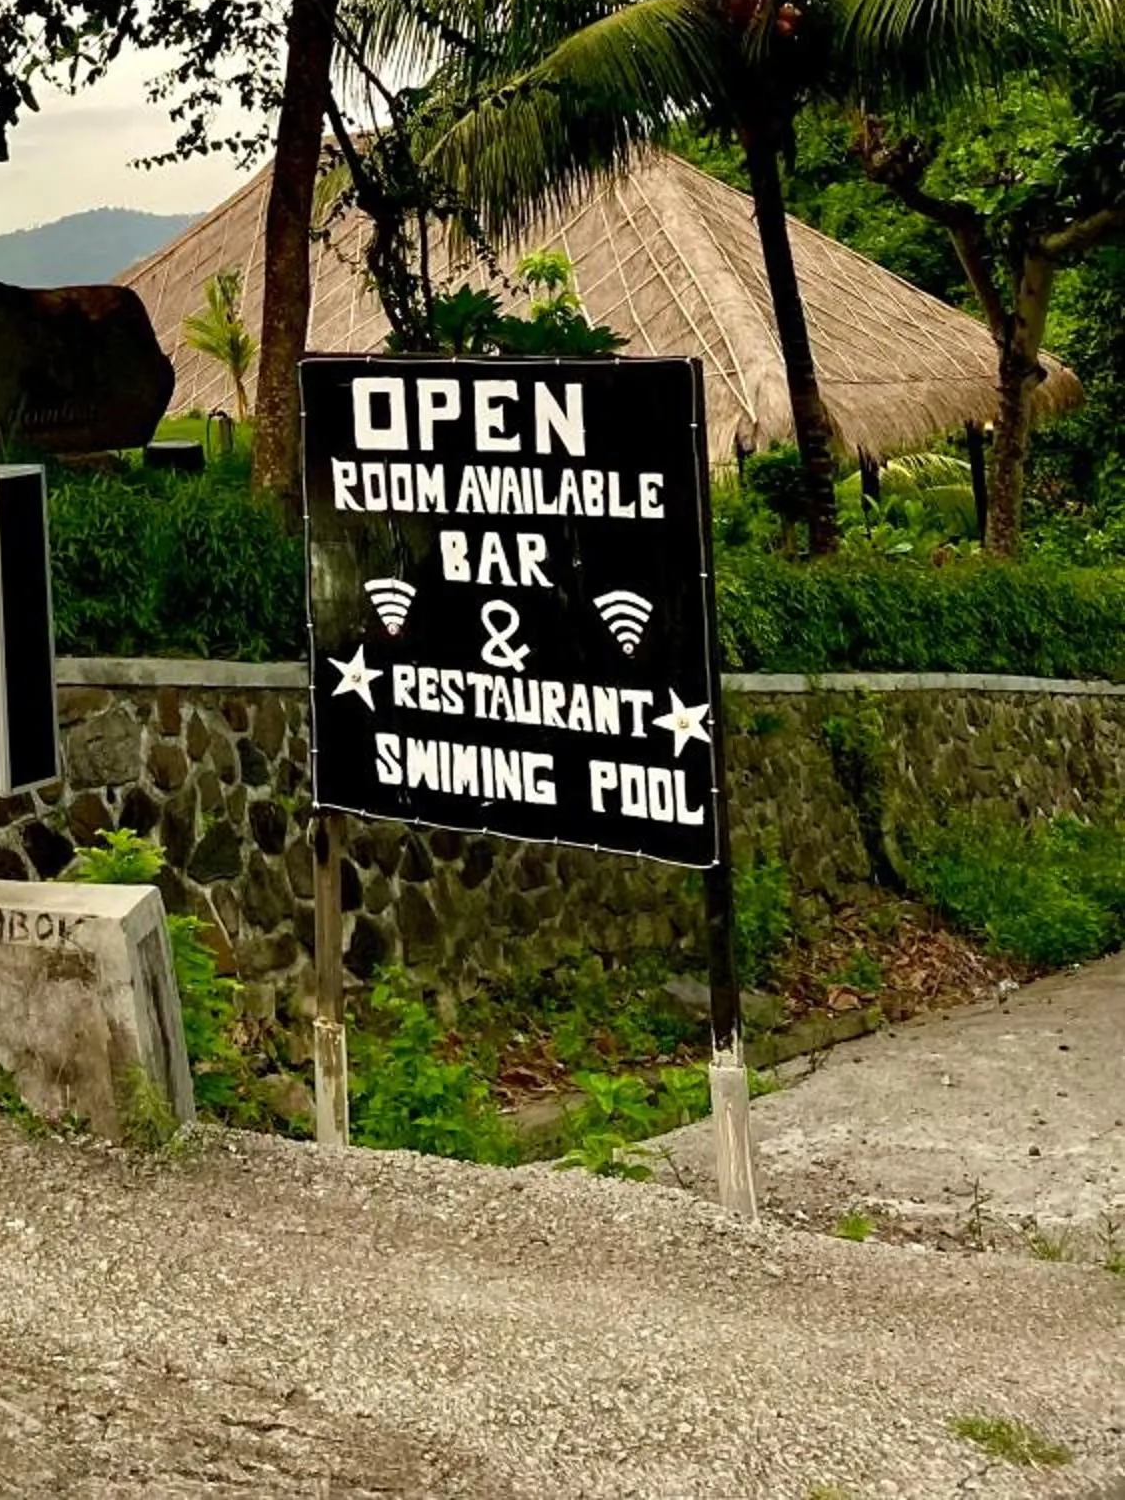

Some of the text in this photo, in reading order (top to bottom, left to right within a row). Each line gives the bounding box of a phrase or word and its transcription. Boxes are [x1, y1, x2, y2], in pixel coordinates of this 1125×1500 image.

[351, 377, 587, 457] OPEN
[331, 456, 666, 520] ROOM AVAILABLE
[439, 529, 555, 588] BAR
[480, 599, 532, 673] &
[392, 663, 655, 739] RESTAURANT
[375, 732, 705, 826] SWIMING POOL
